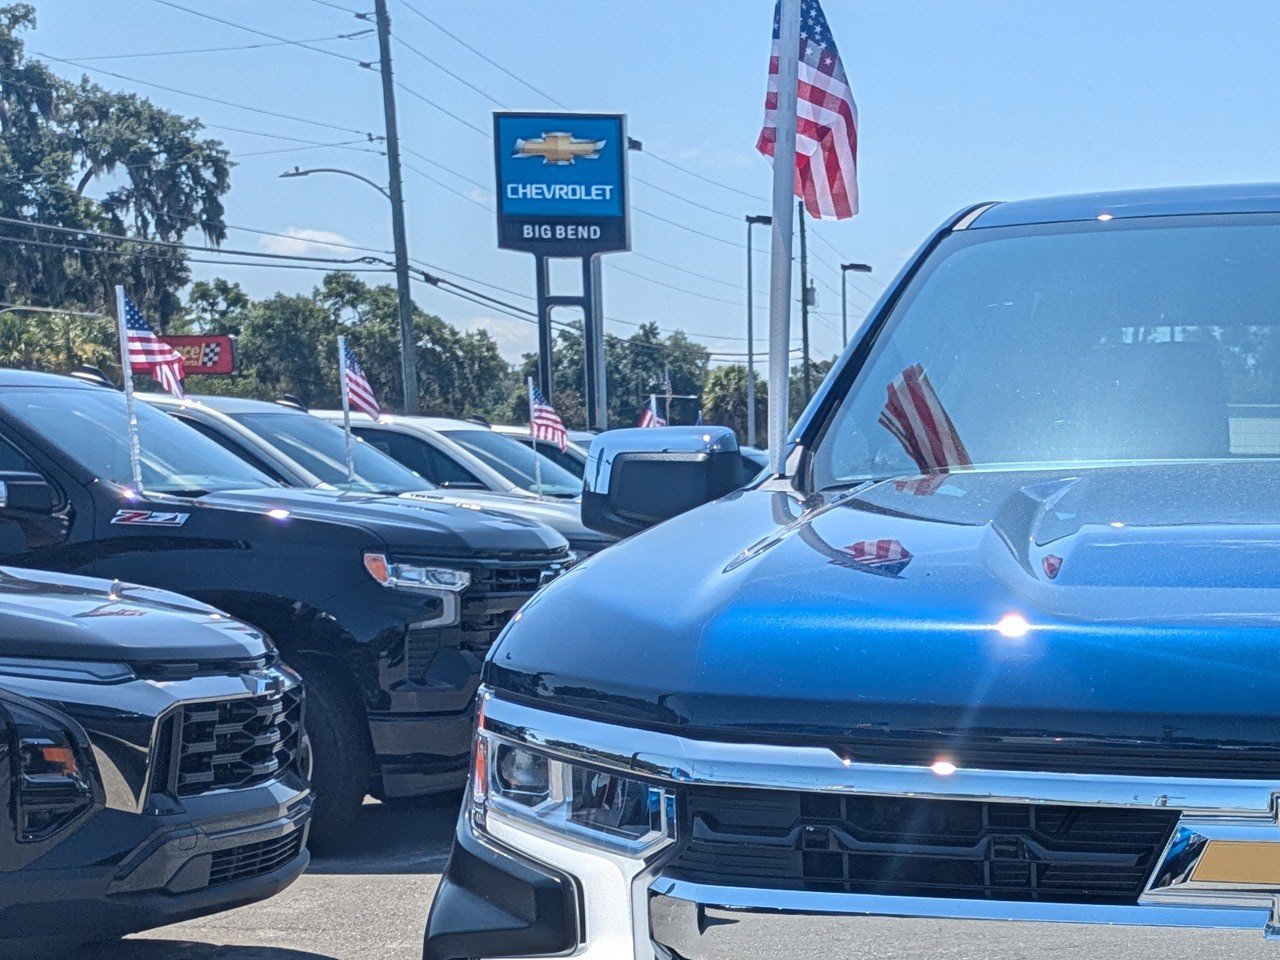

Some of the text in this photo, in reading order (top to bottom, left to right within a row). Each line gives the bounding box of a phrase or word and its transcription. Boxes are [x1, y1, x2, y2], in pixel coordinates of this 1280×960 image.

[506, 183, 613, 200] CHEVROLET
[523, 224, 601, 239] BIG BEND
[110, 509, 190, 527] Z71
